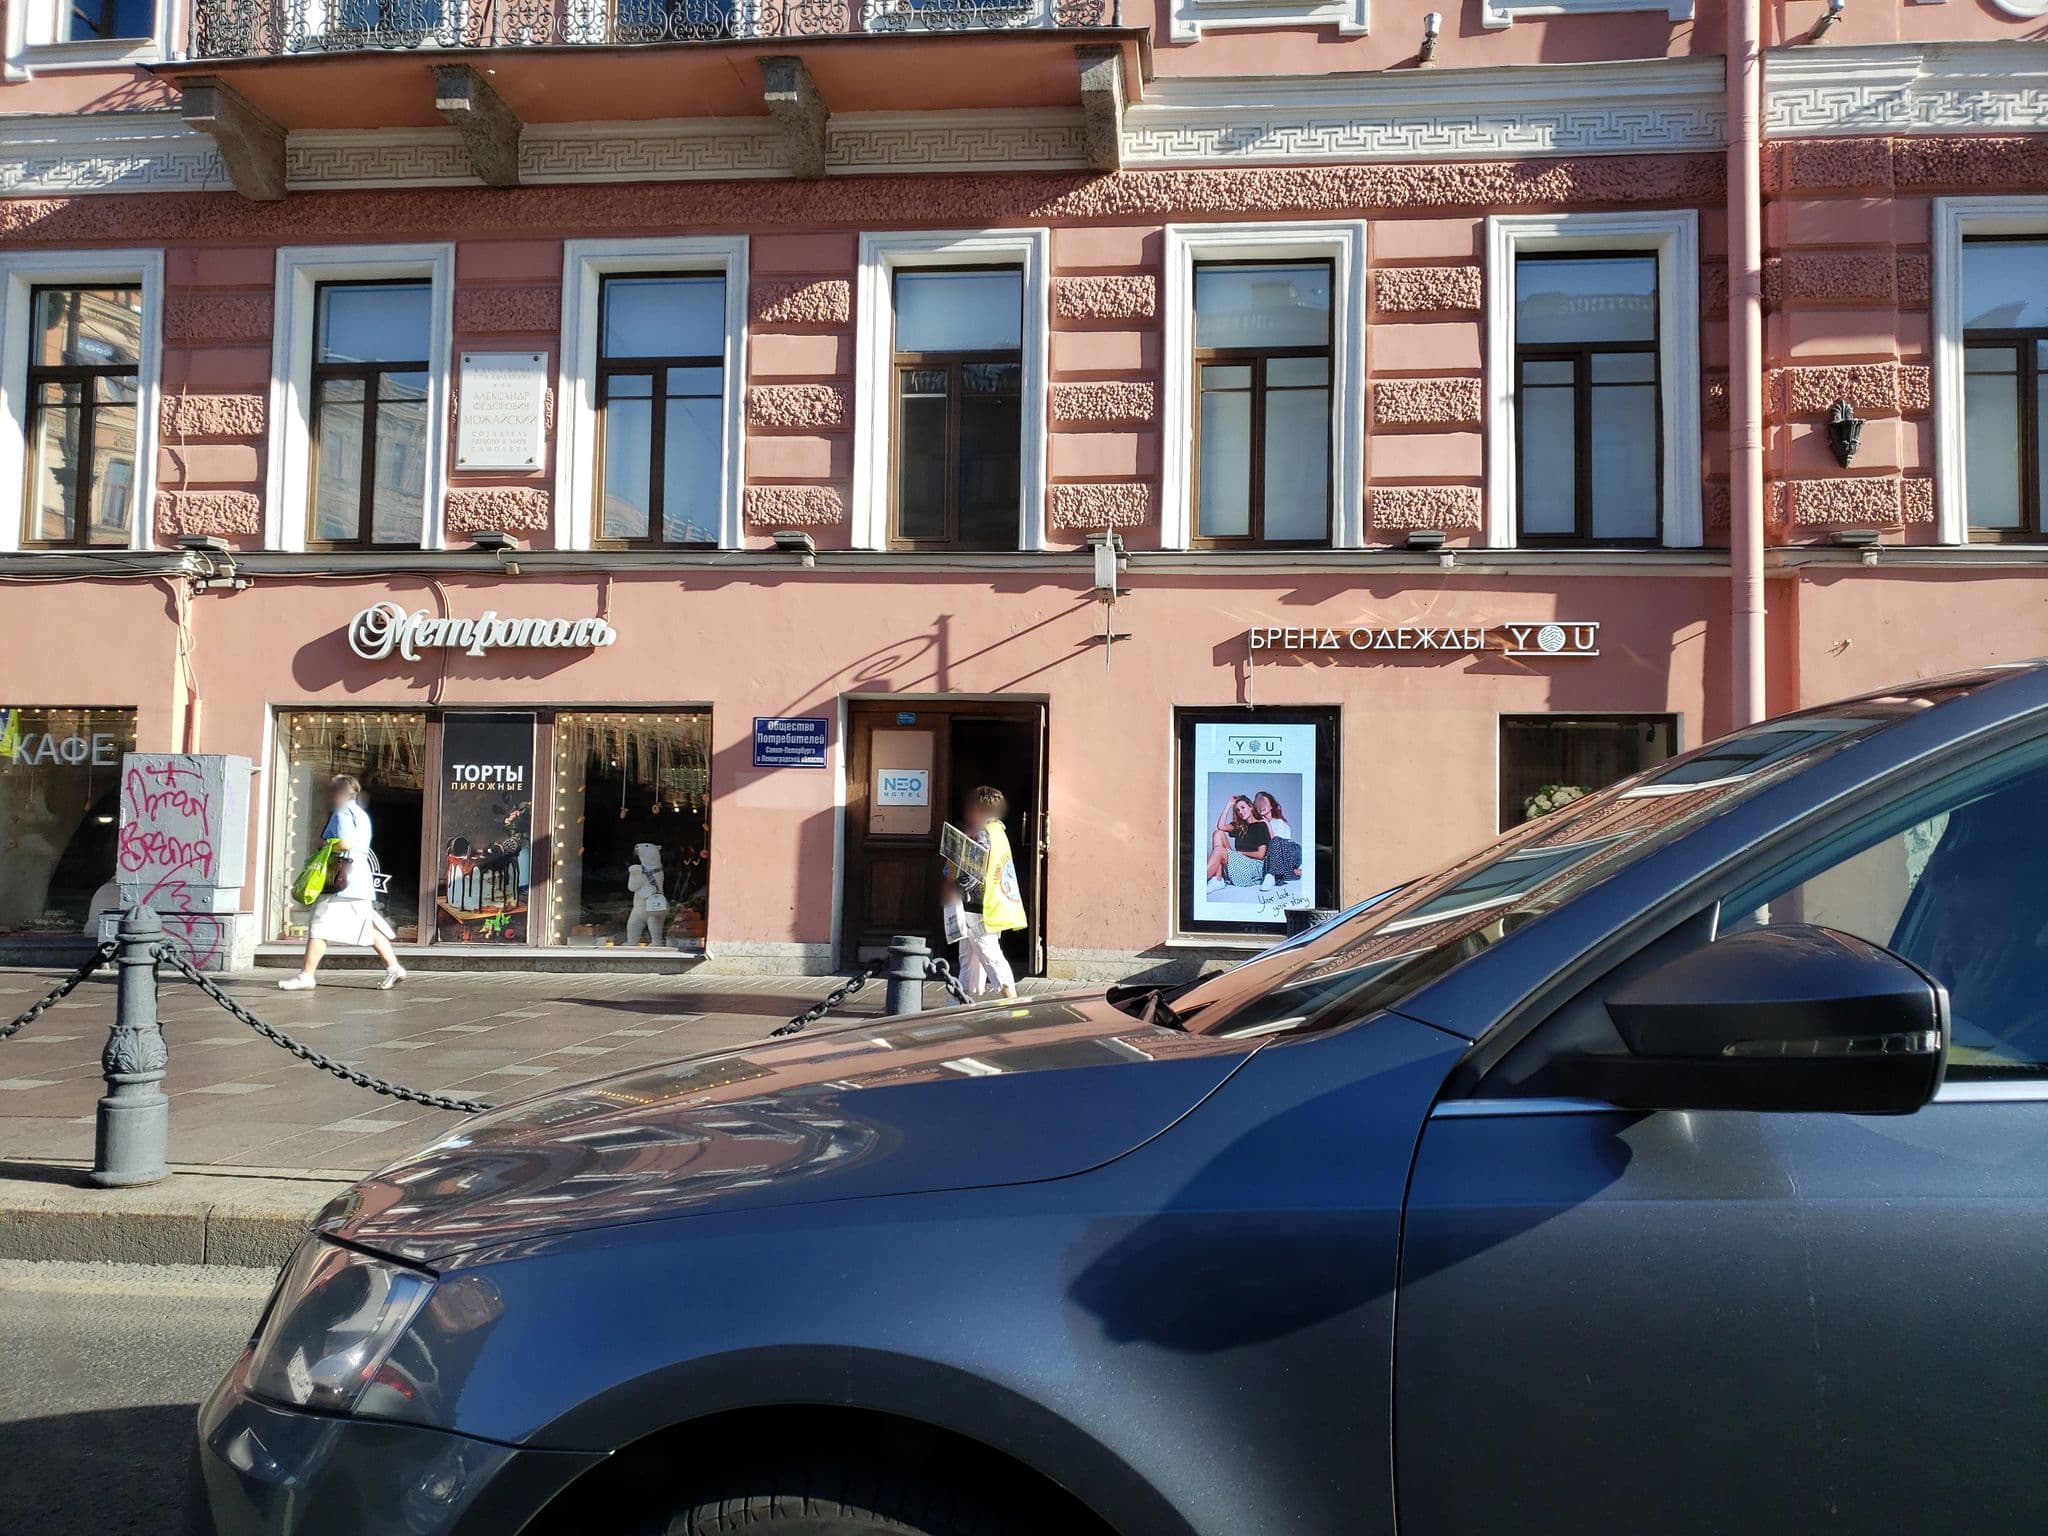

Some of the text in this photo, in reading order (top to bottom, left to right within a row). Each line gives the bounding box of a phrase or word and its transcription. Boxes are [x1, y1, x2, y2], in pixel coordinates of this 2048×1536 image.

[348, 601, 617, 661] Метрополь
[1250, 627, 1486, 650] БРЕНД ОДЕЖДЫ
[767, 721, 816, 732] Общество
[757, 733, 826, 745] Потребителей
[11, 732, 120, 766] КАФЕ
[452, 764, 524, 782] ТОРТЫ
[451, 782, 524, 791] ПИРОЖНЫЕ
[884, 777, 922, 791] NEO
